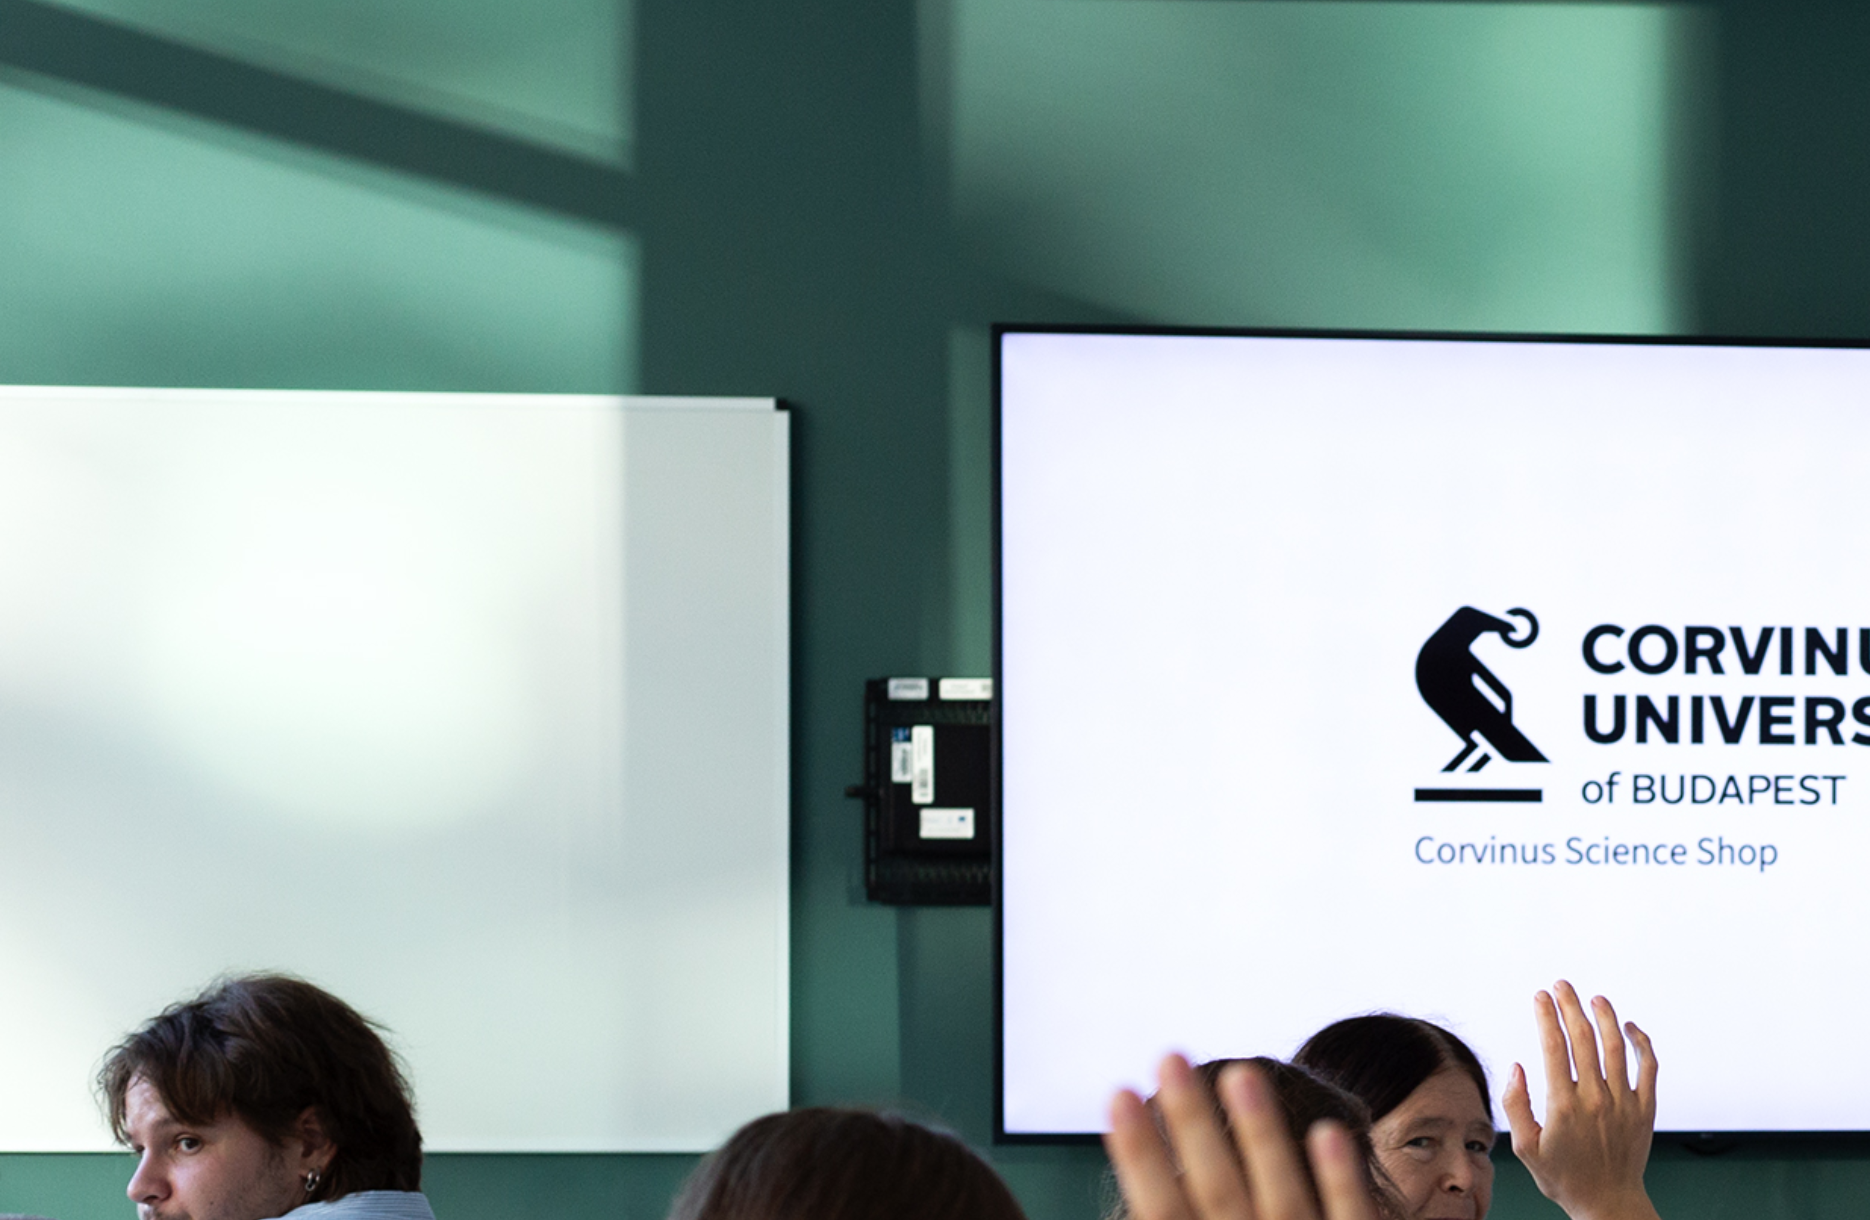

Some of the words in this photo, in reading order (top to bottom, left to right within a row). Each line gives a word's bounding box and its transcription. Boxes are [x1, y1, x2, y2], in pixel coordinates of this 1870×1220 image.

[1581, 771, 1622, 805] of
[1632, 773, 1847, 806] BUDAPEST
[1414, 835, 1557, 866] Corvinus
[1565, 836, 1689, 866] Science
[1697, 836, 1779, 873] Shop
